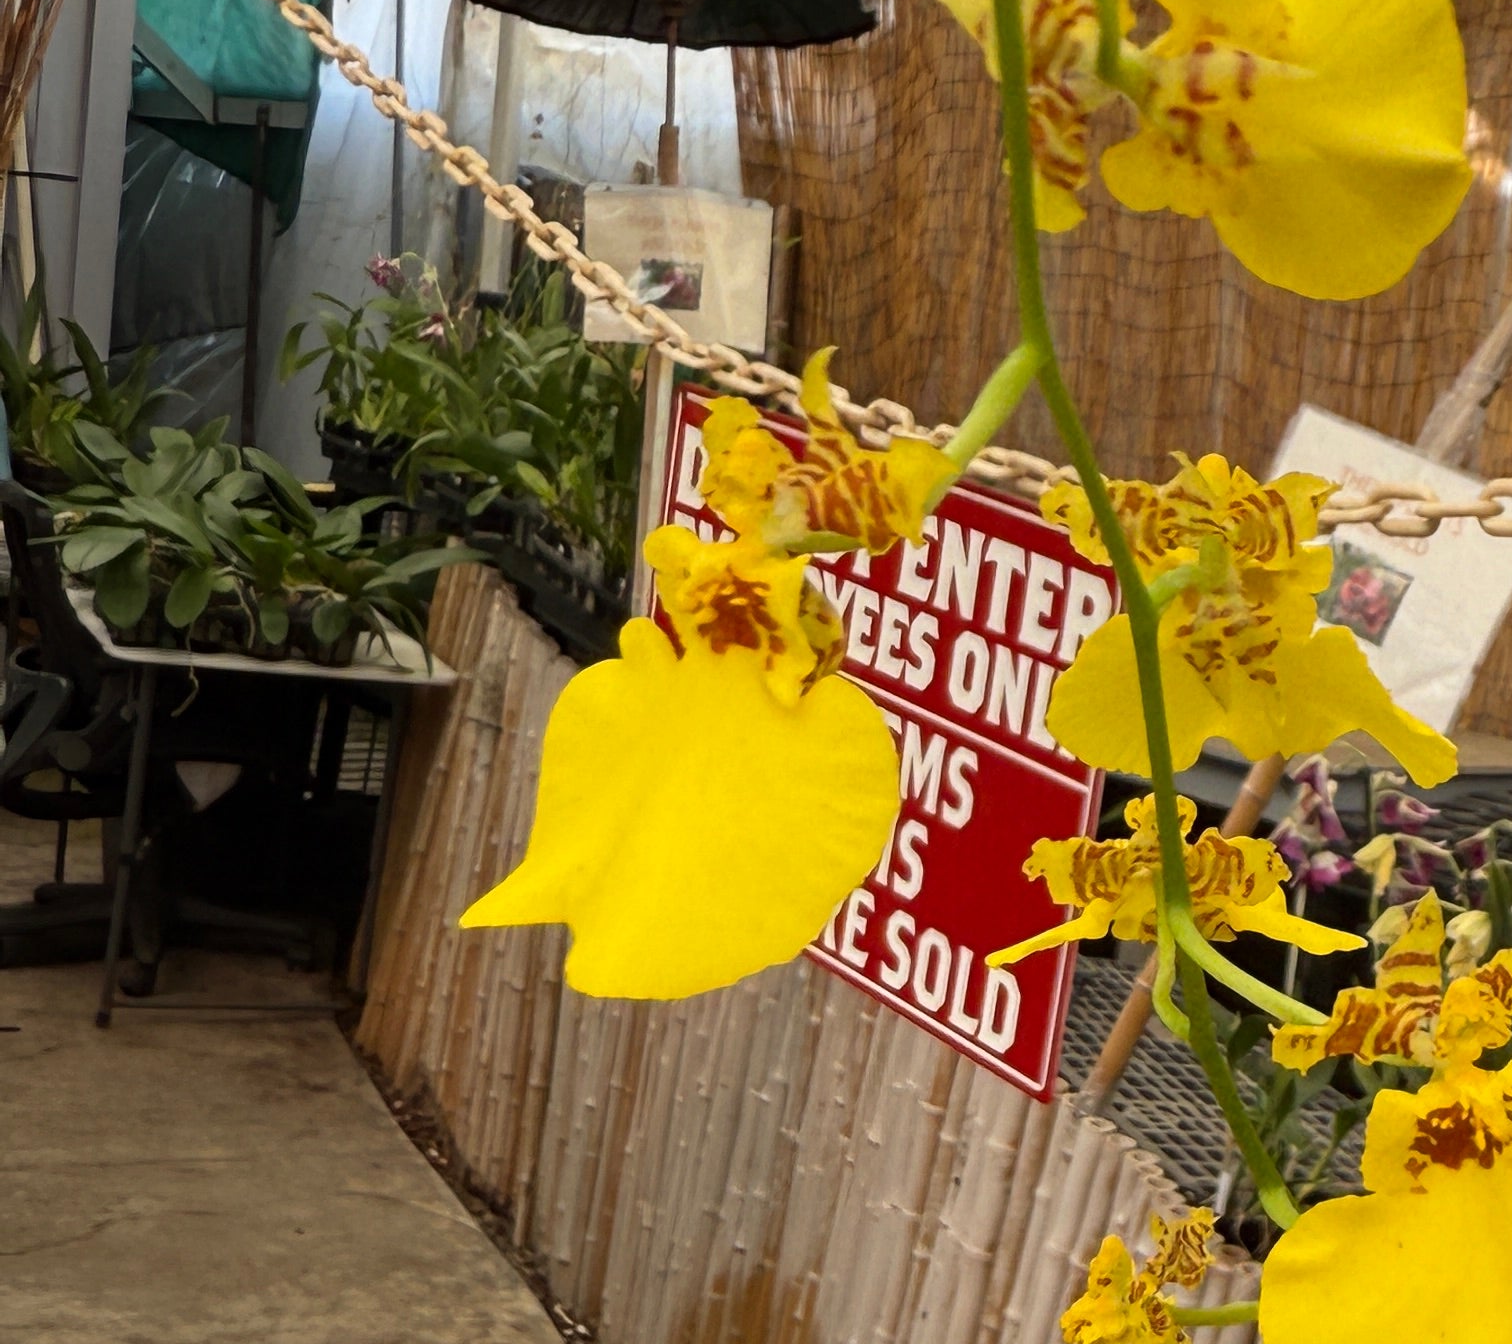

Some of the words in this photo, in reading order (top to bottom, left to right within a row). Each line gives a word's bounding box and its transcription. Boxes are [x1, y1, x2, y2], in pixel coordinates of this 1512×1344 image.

[675, 423, 711, 511] D
[897, 515, 1114, 664] ENTER
[948, 629, 1077, 762] ONL
[879, 908, 1022, 1055] SOLD
